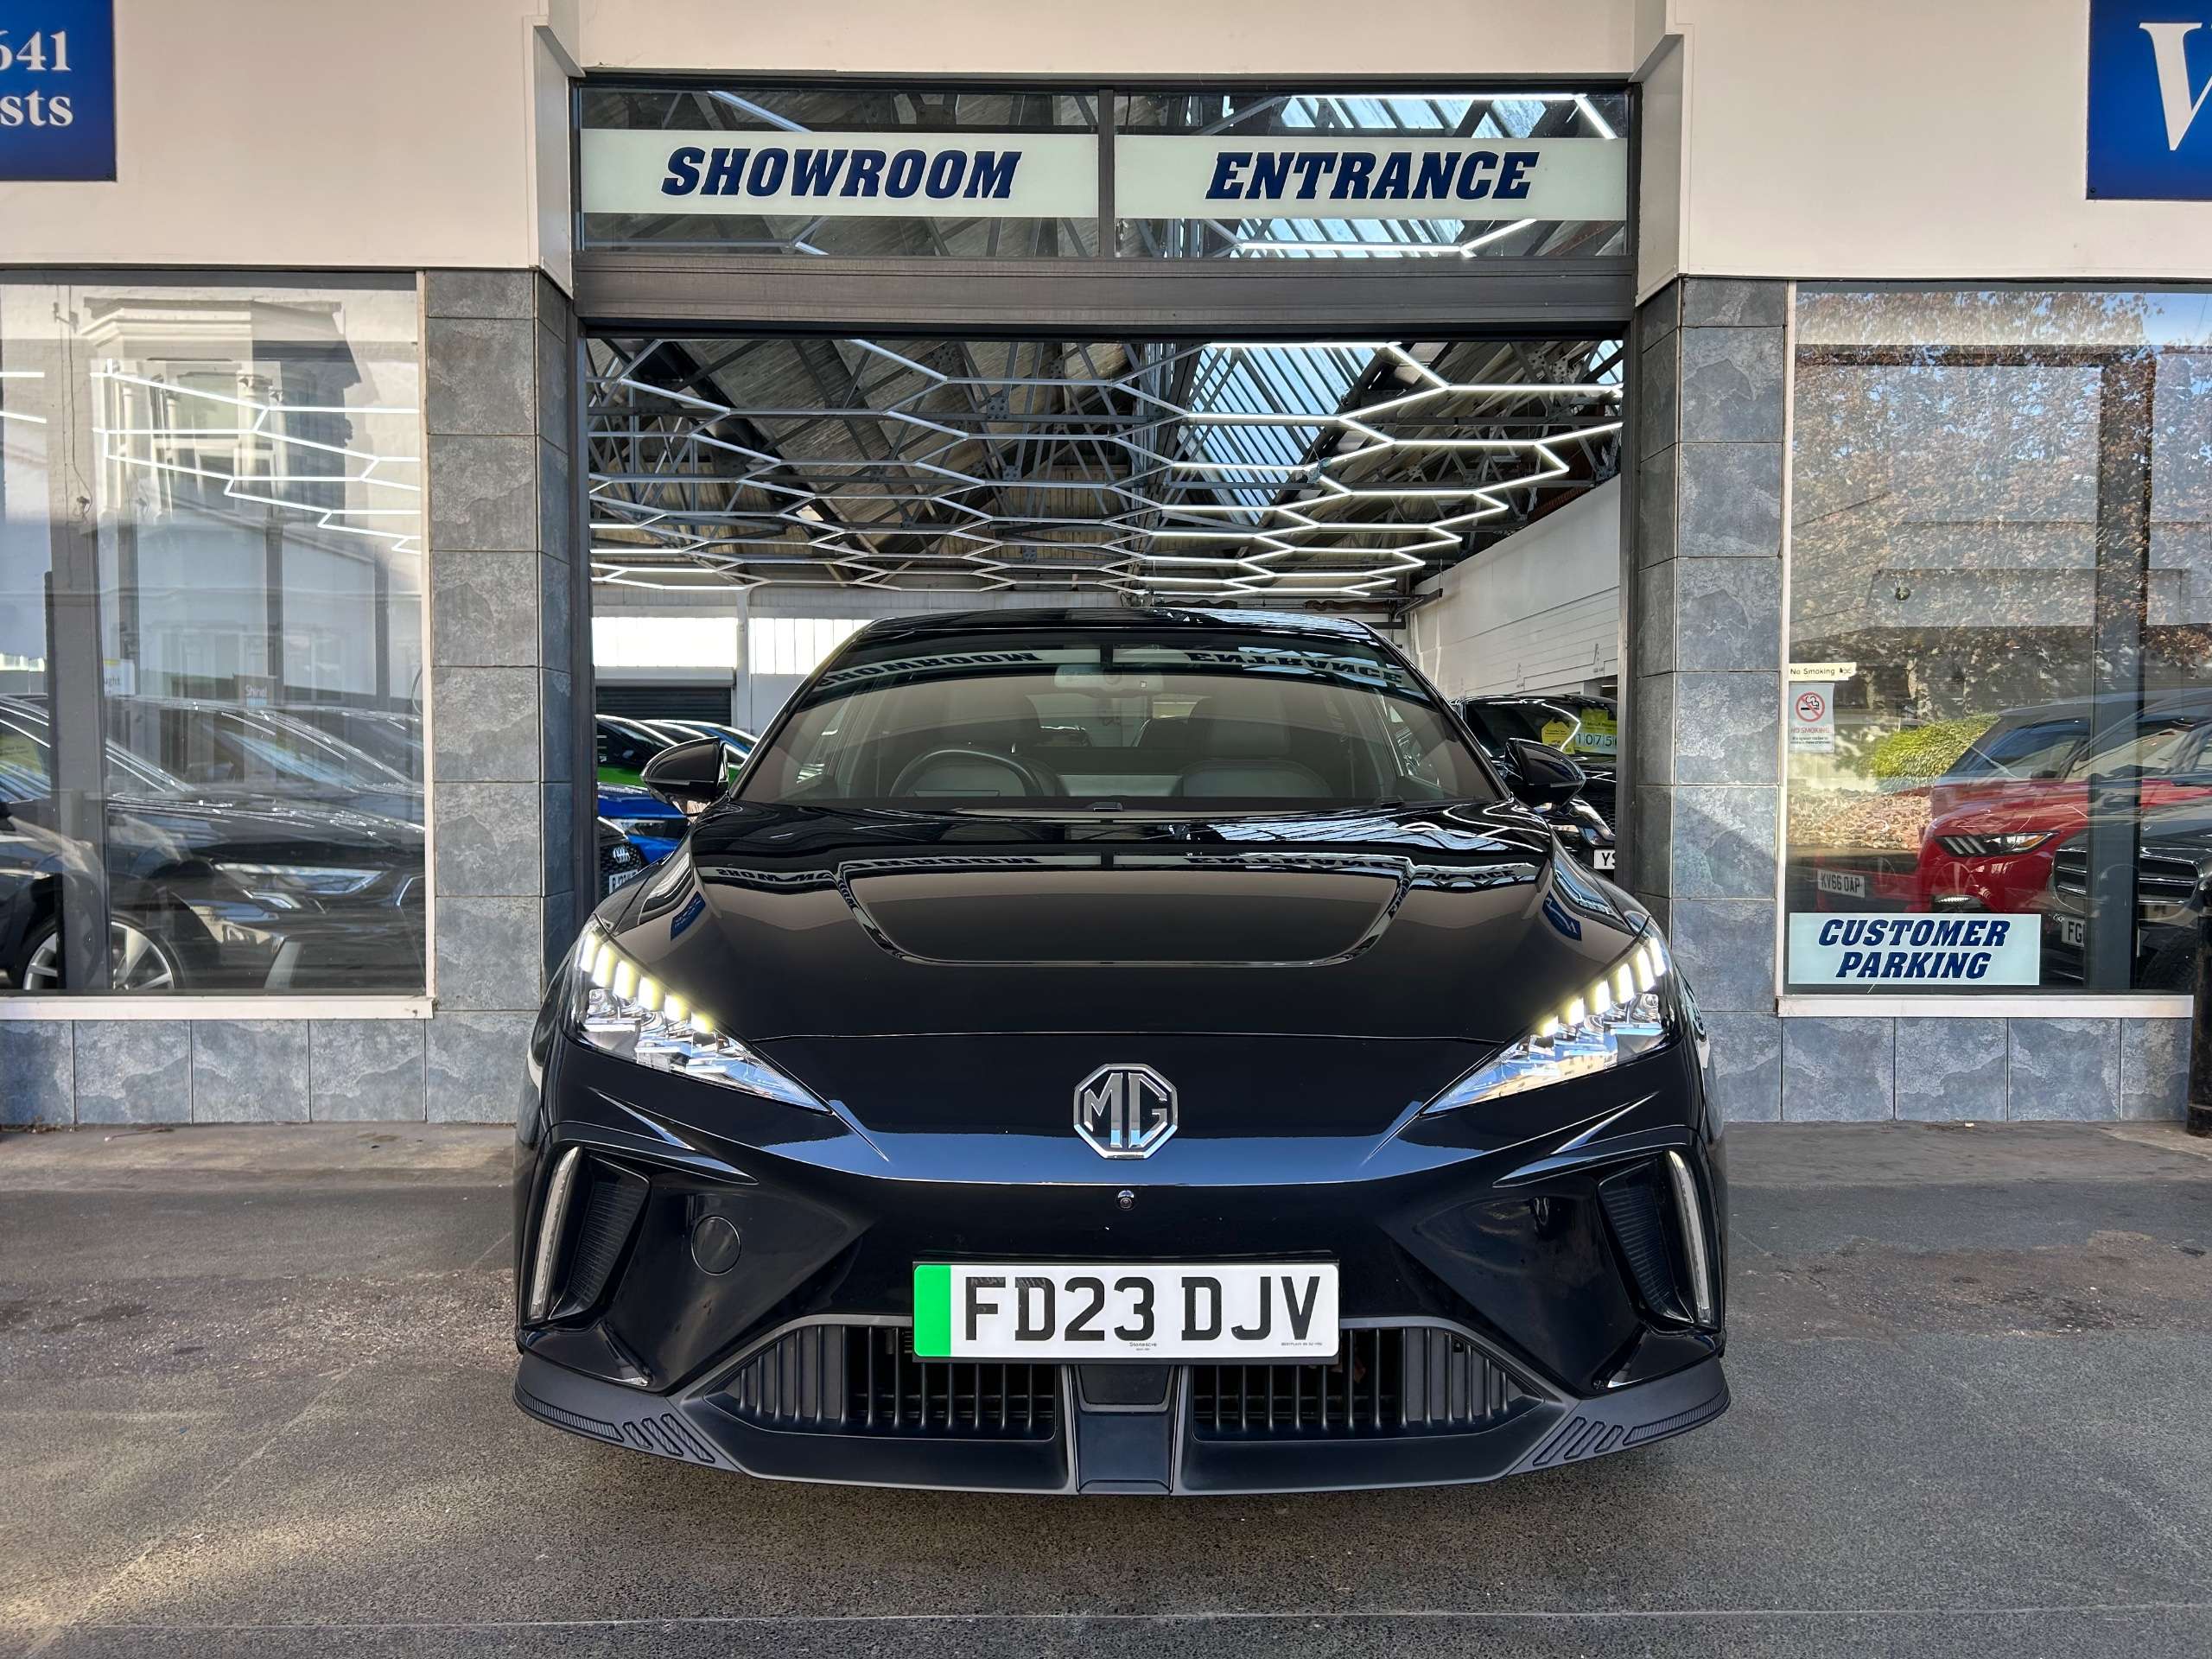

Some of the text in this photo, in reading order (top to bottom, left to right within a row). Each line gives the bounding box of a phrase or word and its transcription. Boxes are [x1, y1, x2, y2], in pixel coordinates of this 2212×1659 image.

[661, 146, 1540, 200] SHOWROOM ENTRANCE
[1578, 733, 1617, 747] 1075
[1818, 919, 2011, 947] CUSTOMER
[2068, 921, 2085, 944] FG
[1835, 951, 1991, 979] PARKING
[1083, 1072, 1168, 1148] MG
[965, 1276, 1321, 1341] FD23 DJV
